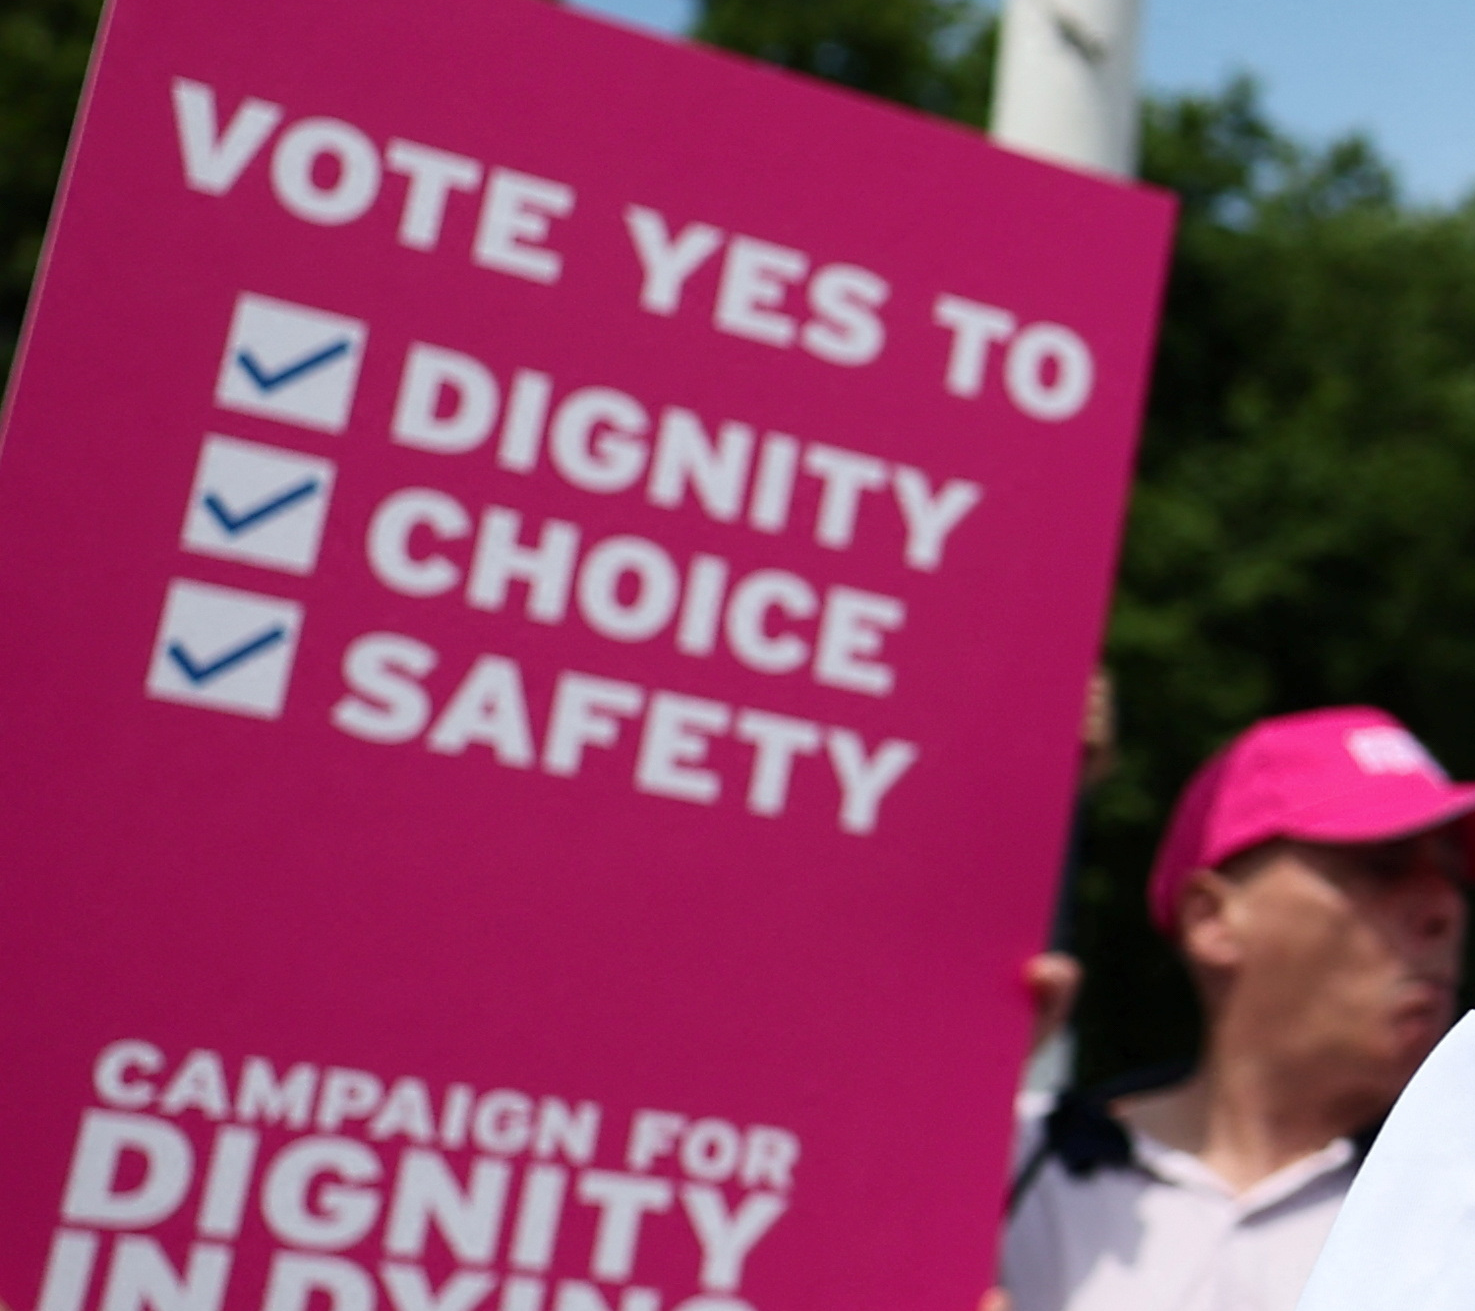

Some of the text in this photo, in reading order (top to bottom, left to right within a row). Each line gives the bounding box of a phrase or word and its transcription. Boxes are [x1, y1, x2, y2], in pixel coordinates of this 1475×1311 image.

[174, 81, 1091, 418] VOTE YES TO
[394, 346, 977, 568] DIGNITY
[369, 491, 902, 692] CHOICE
[336, 635, 912, 831] SAFETY
[63, 1111, 783, 1304] DIGNITY
[96, 1044, 796, 1188] CAMPAIGN FOR
